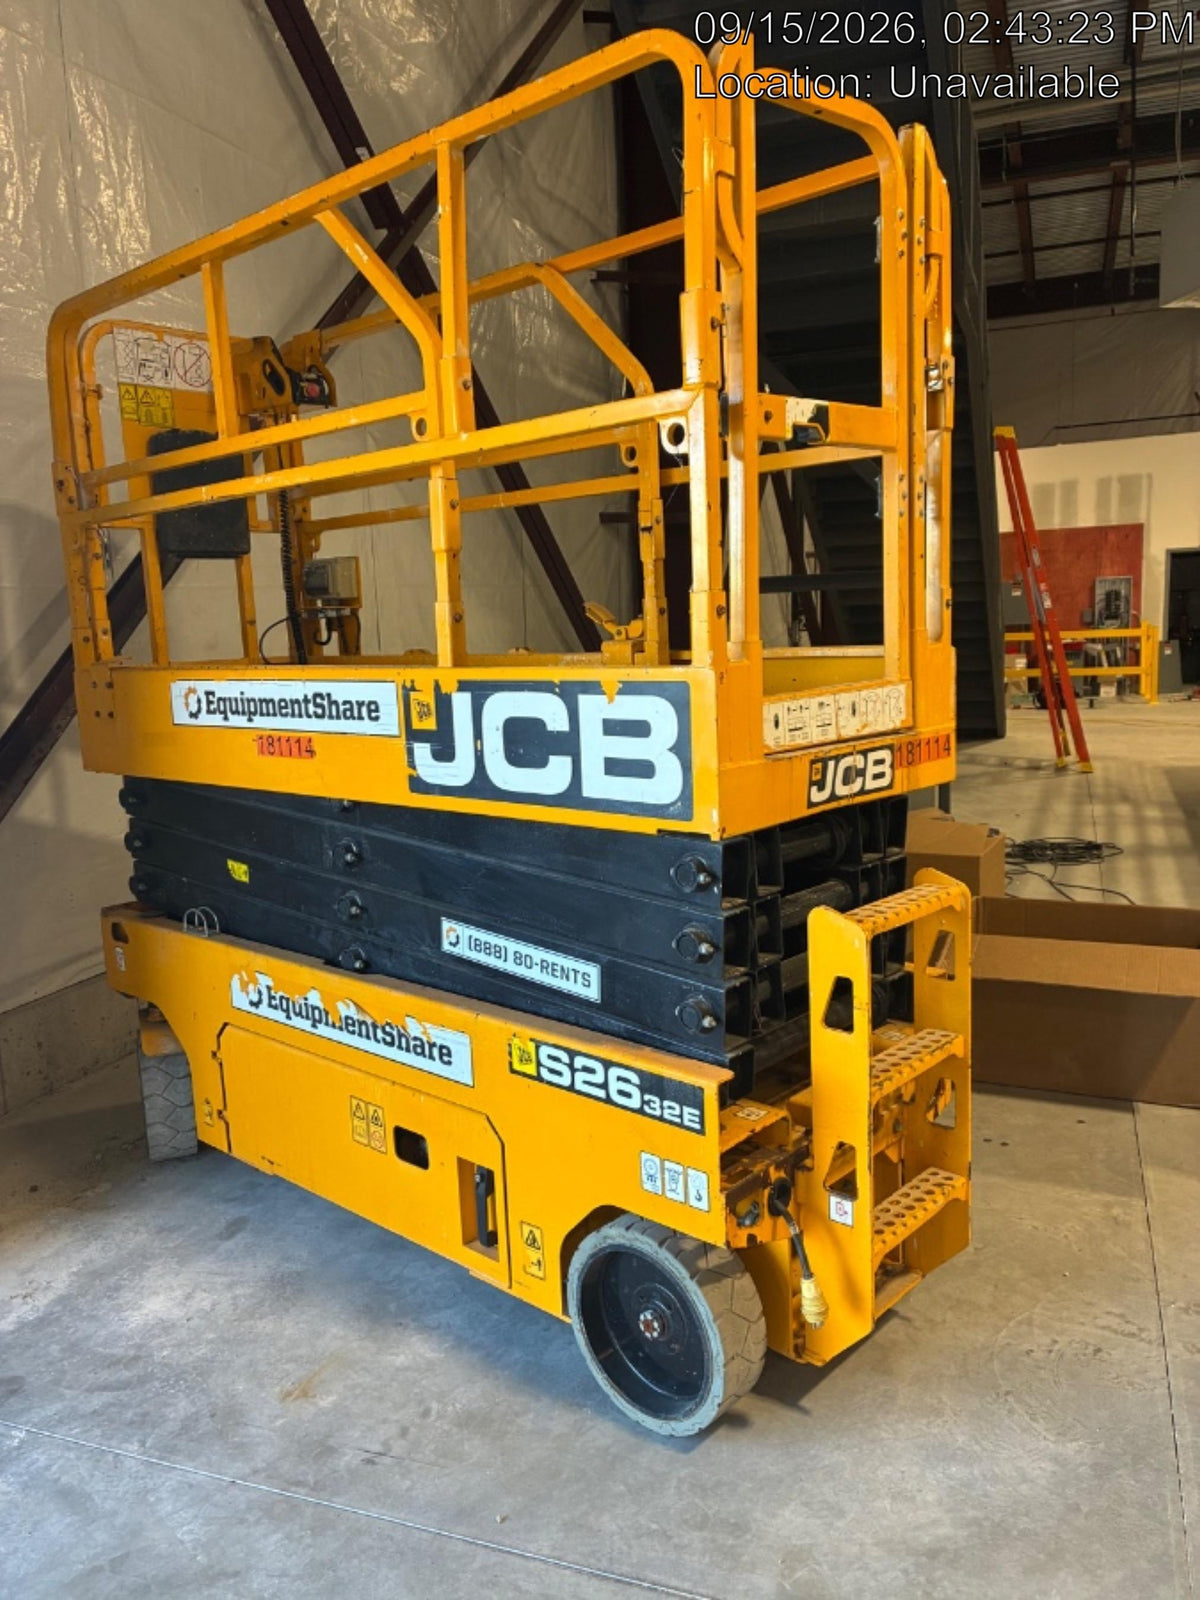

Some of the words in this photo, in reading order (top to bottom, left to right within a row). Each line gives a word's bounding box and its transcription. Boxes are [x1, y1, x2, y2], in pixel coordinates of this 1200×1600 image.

[204, 690, 381, 723] EquipmentShare
[256, 734, 317, 758] 181114
[413, 690, 684, 805] JCB
[895, 733, 951, 767] 181114
[810, 748, 893, 803] JCB
[468, 934, 508, 963] (888)
[513, 950, 592, 988] 80-RENTS
